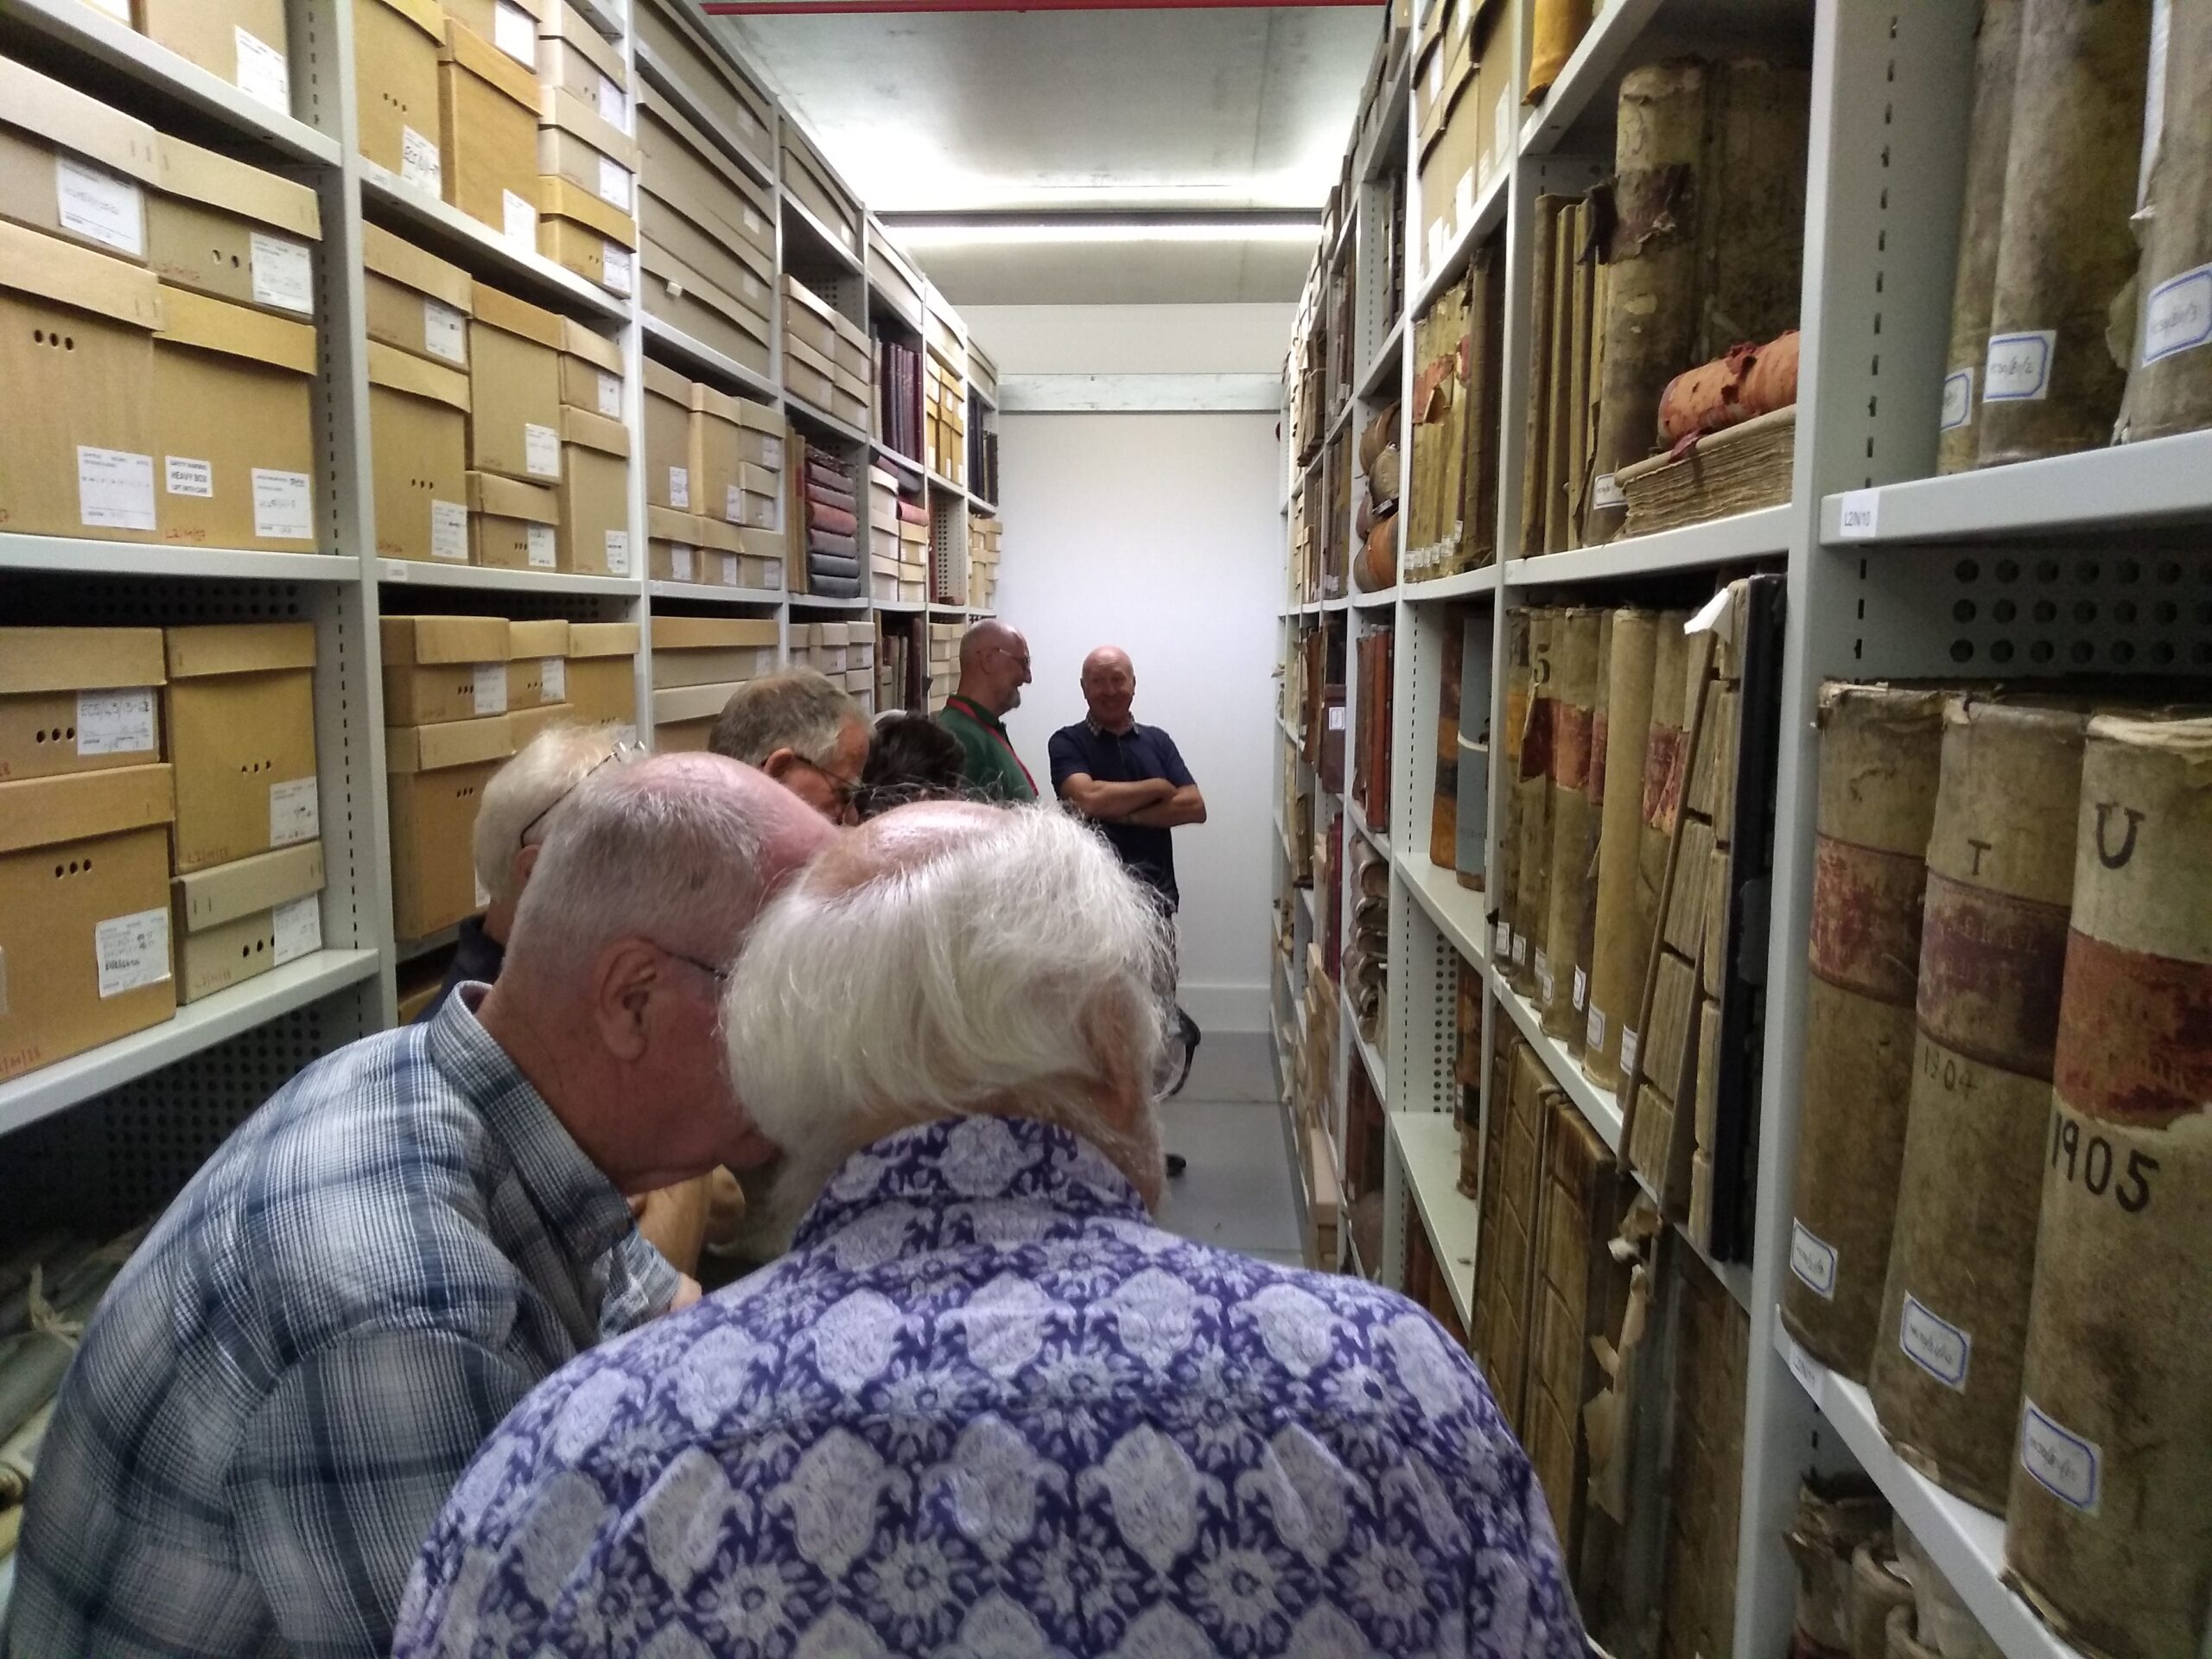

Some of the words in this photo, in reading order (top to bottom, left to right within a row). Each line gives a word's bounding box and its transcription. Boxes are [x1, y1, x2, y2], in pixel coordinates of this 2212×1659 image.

[171, 471, 193, 481] HEAVY
[194, 473, 207, 483] BOX
[1533, 642, 1551, 684] 5
[1967, 838, 1993, 876] T
[2094, 802, 2145, 870] U
[1923, 1044, 1979, 1101] 1904
[2051, 1114, 2160, 1214] 1905
